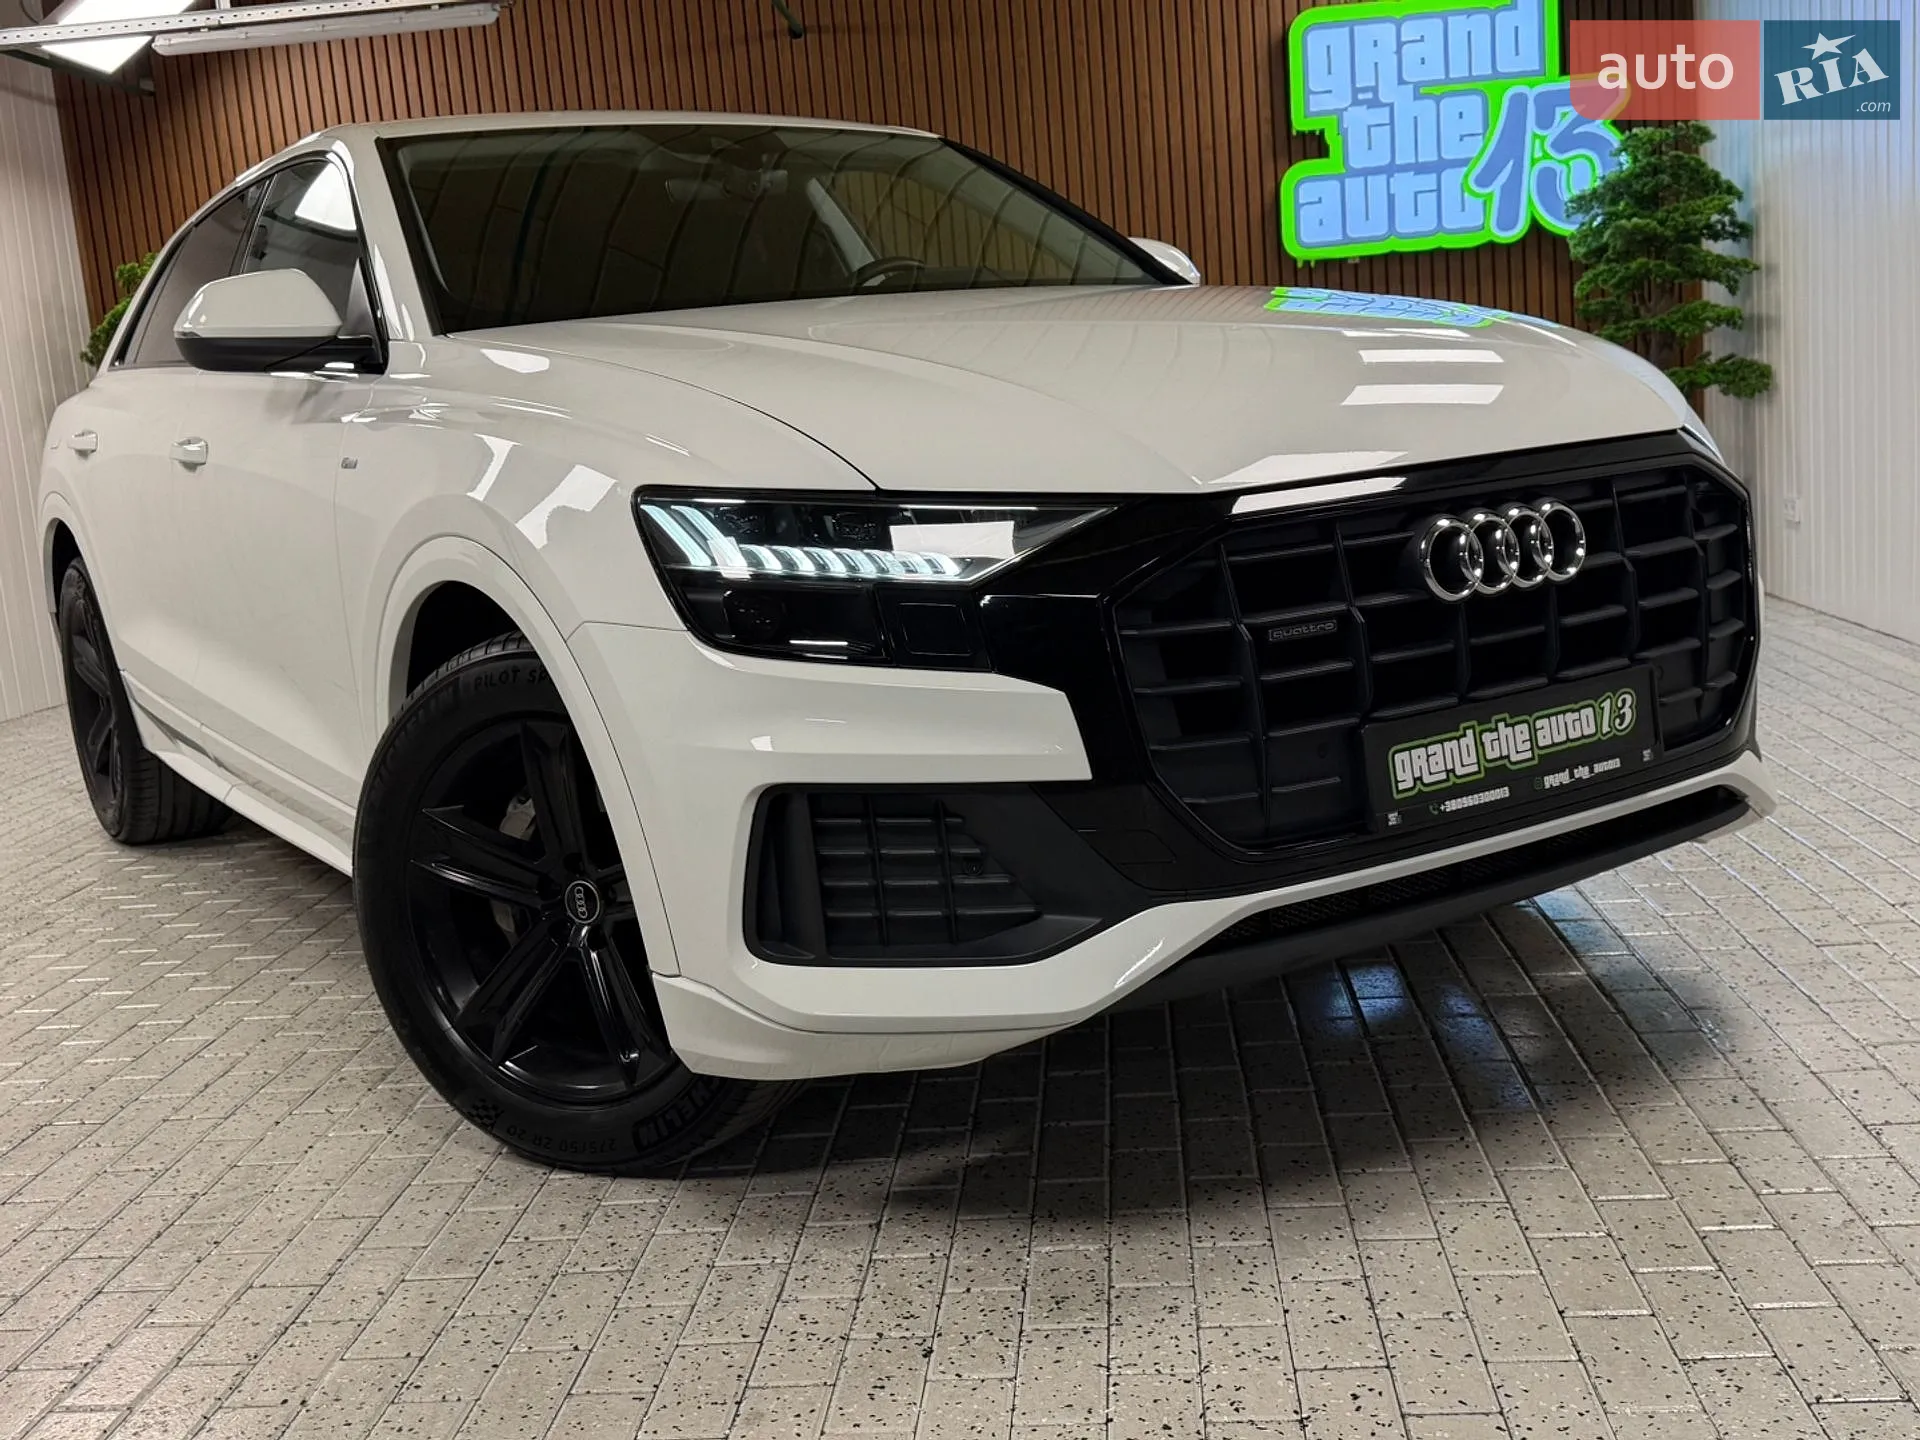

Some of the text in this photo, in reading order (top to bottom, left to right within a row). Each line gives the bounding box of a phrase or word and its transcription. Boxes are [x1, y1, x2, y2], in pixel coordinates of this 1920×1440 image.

[1344, 84, 1484, 168] the
[1273, 622, 1334, 639] quattro
[474, 668, 520, 691] PILOT
[1482, 722, 1532, 764] the
[1535, 707, 1596, 747] auto
[1599, 693, 1635, 735] 13
[506, 1124, 527, 1141] 20
